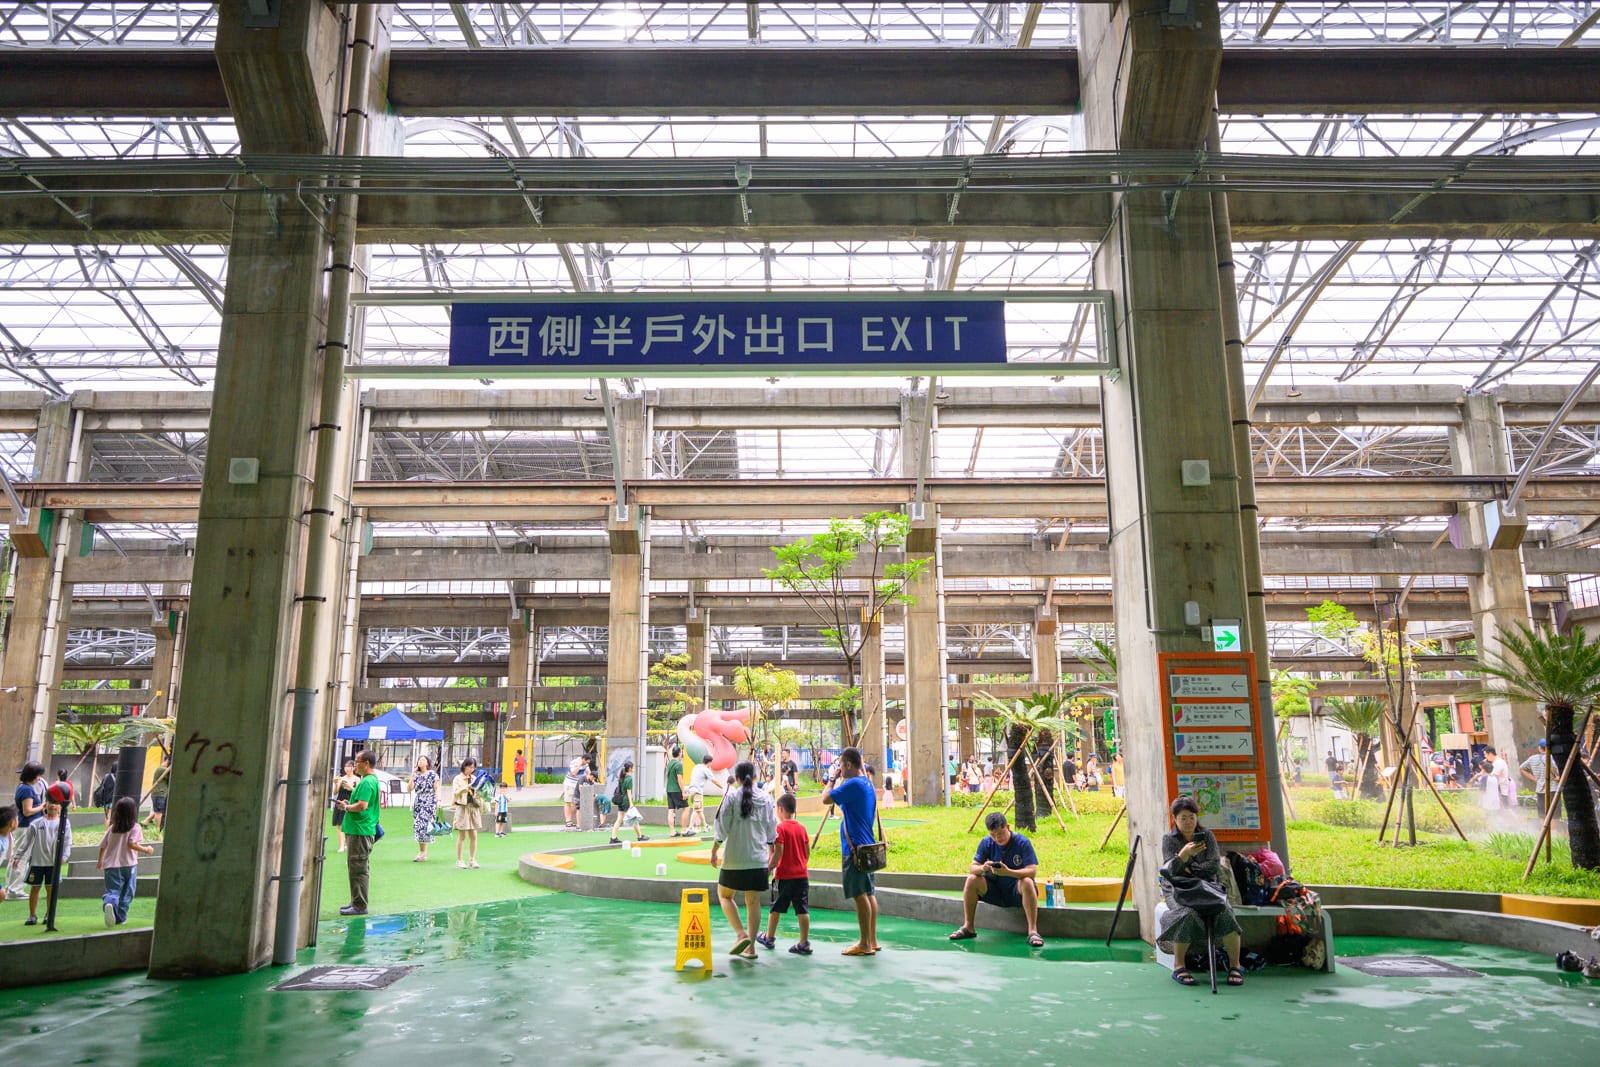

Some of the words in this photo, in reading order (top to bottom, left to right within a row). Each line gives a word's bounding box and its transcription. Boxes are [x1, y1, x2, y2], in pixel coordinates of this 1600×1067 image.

[487, 314, 834, 356] 西側半戶外出口
[861, 316, 969, 352] EXIT
[184, 732, 243, 776] 72
